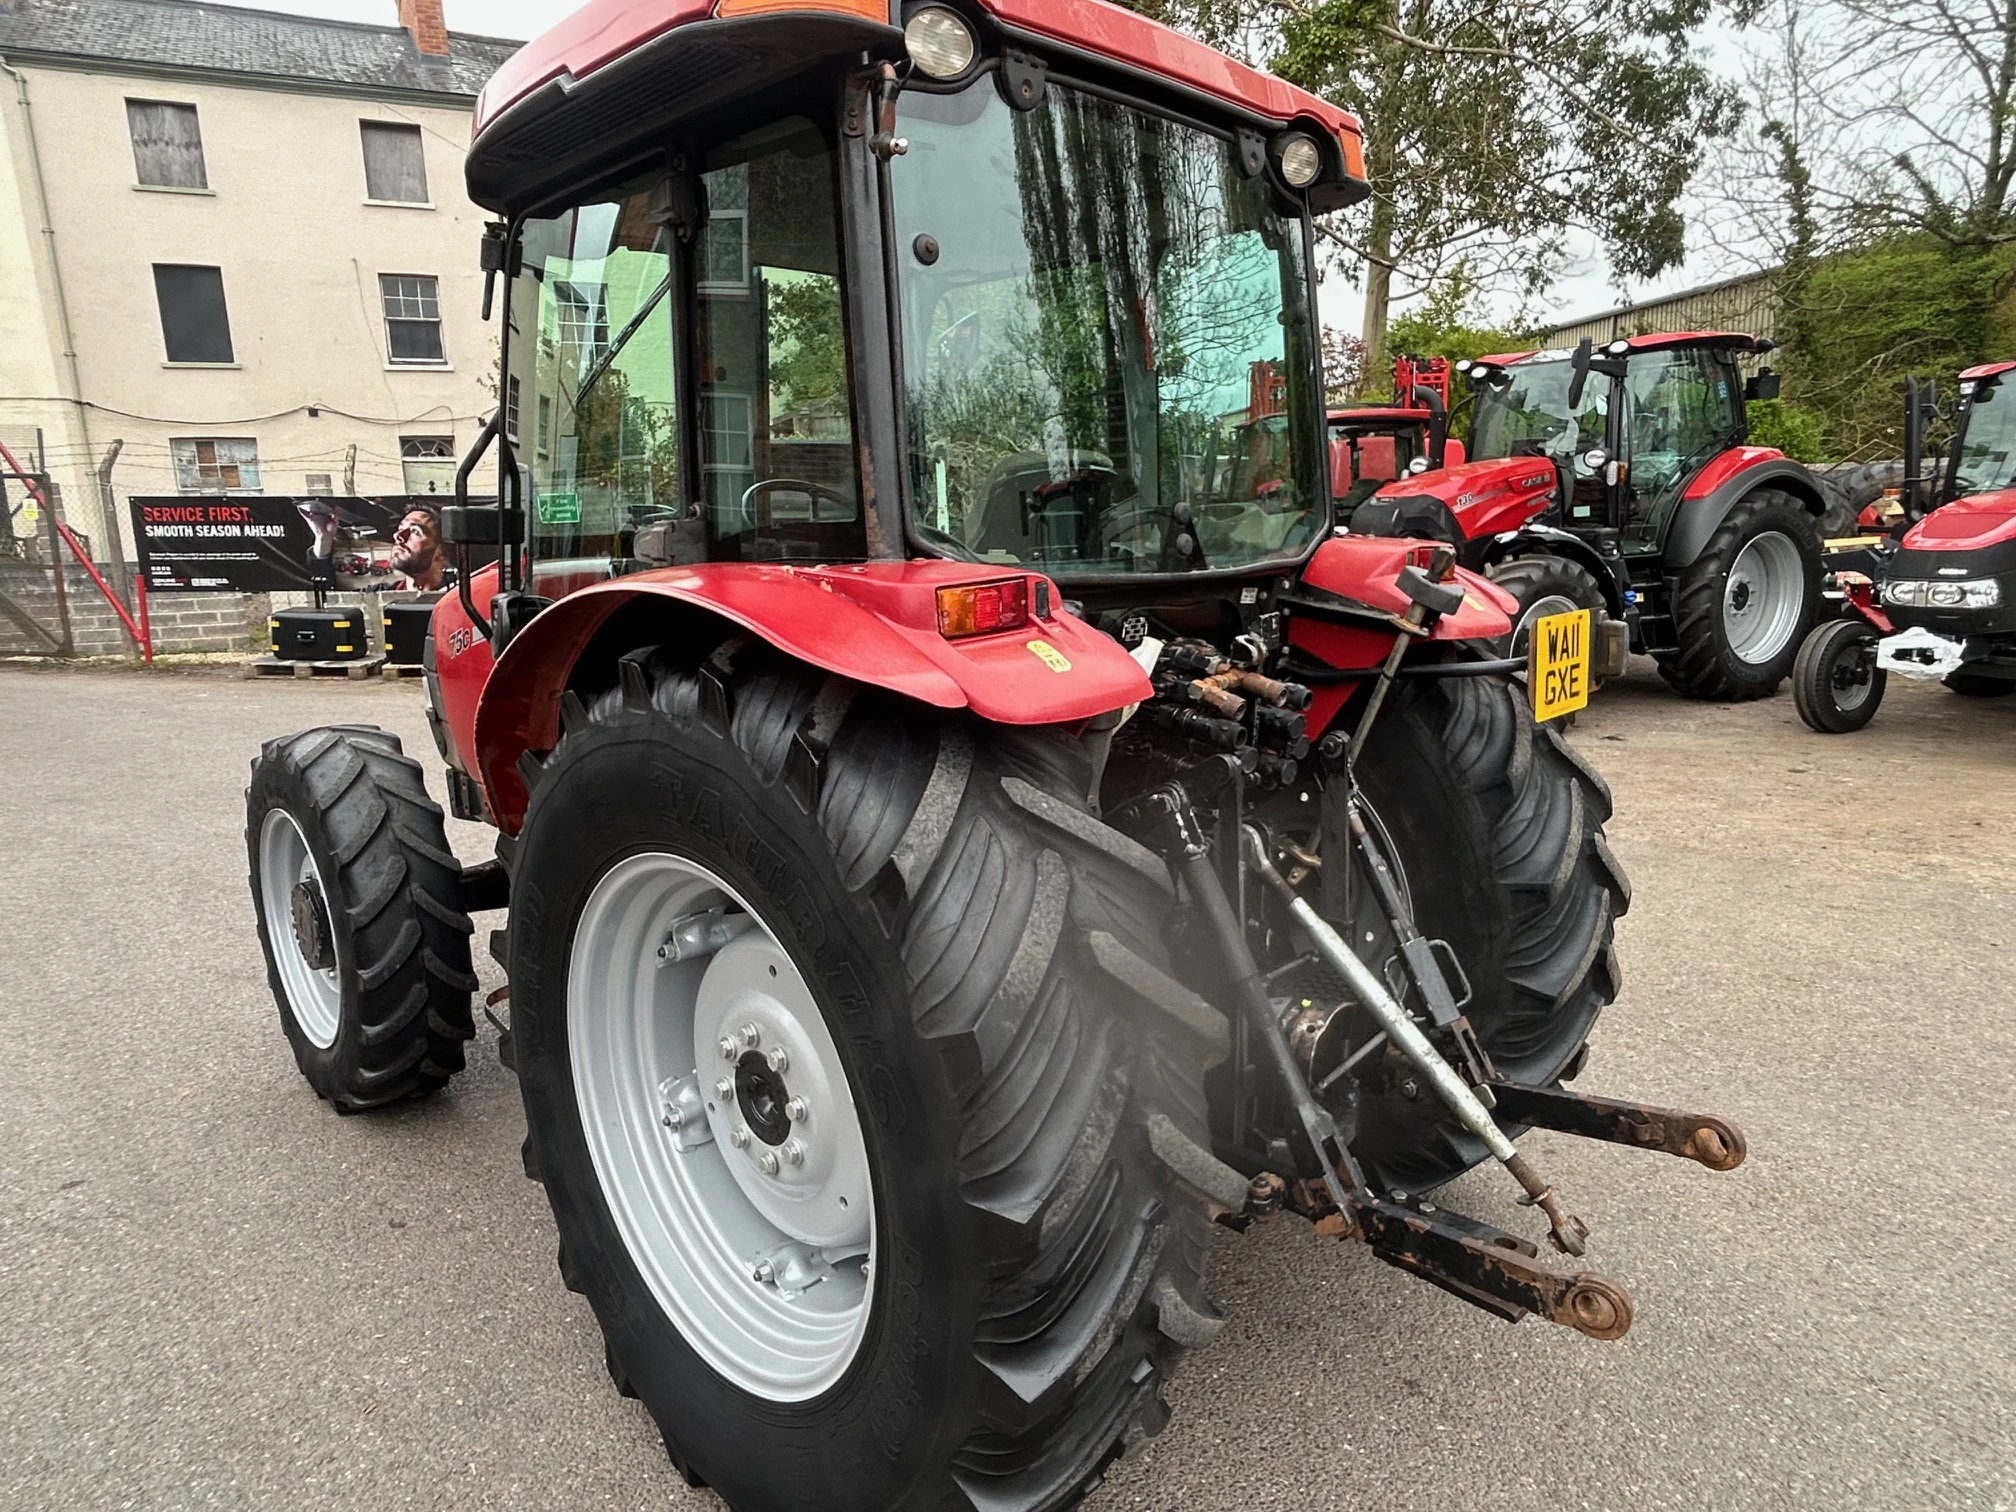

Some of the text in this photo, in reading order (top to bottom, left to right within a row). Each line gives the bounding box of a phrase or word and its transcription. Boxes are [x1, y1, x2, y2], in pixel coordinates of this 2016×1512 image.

[1457, 492, 1474, 506] 130
[144, 506, 254, 523] SERVICE FIRST,
[145, 525, 286, 537] SMOOTH SEASON AHEAD!
[1544, 663, 1580, 706] GXE
